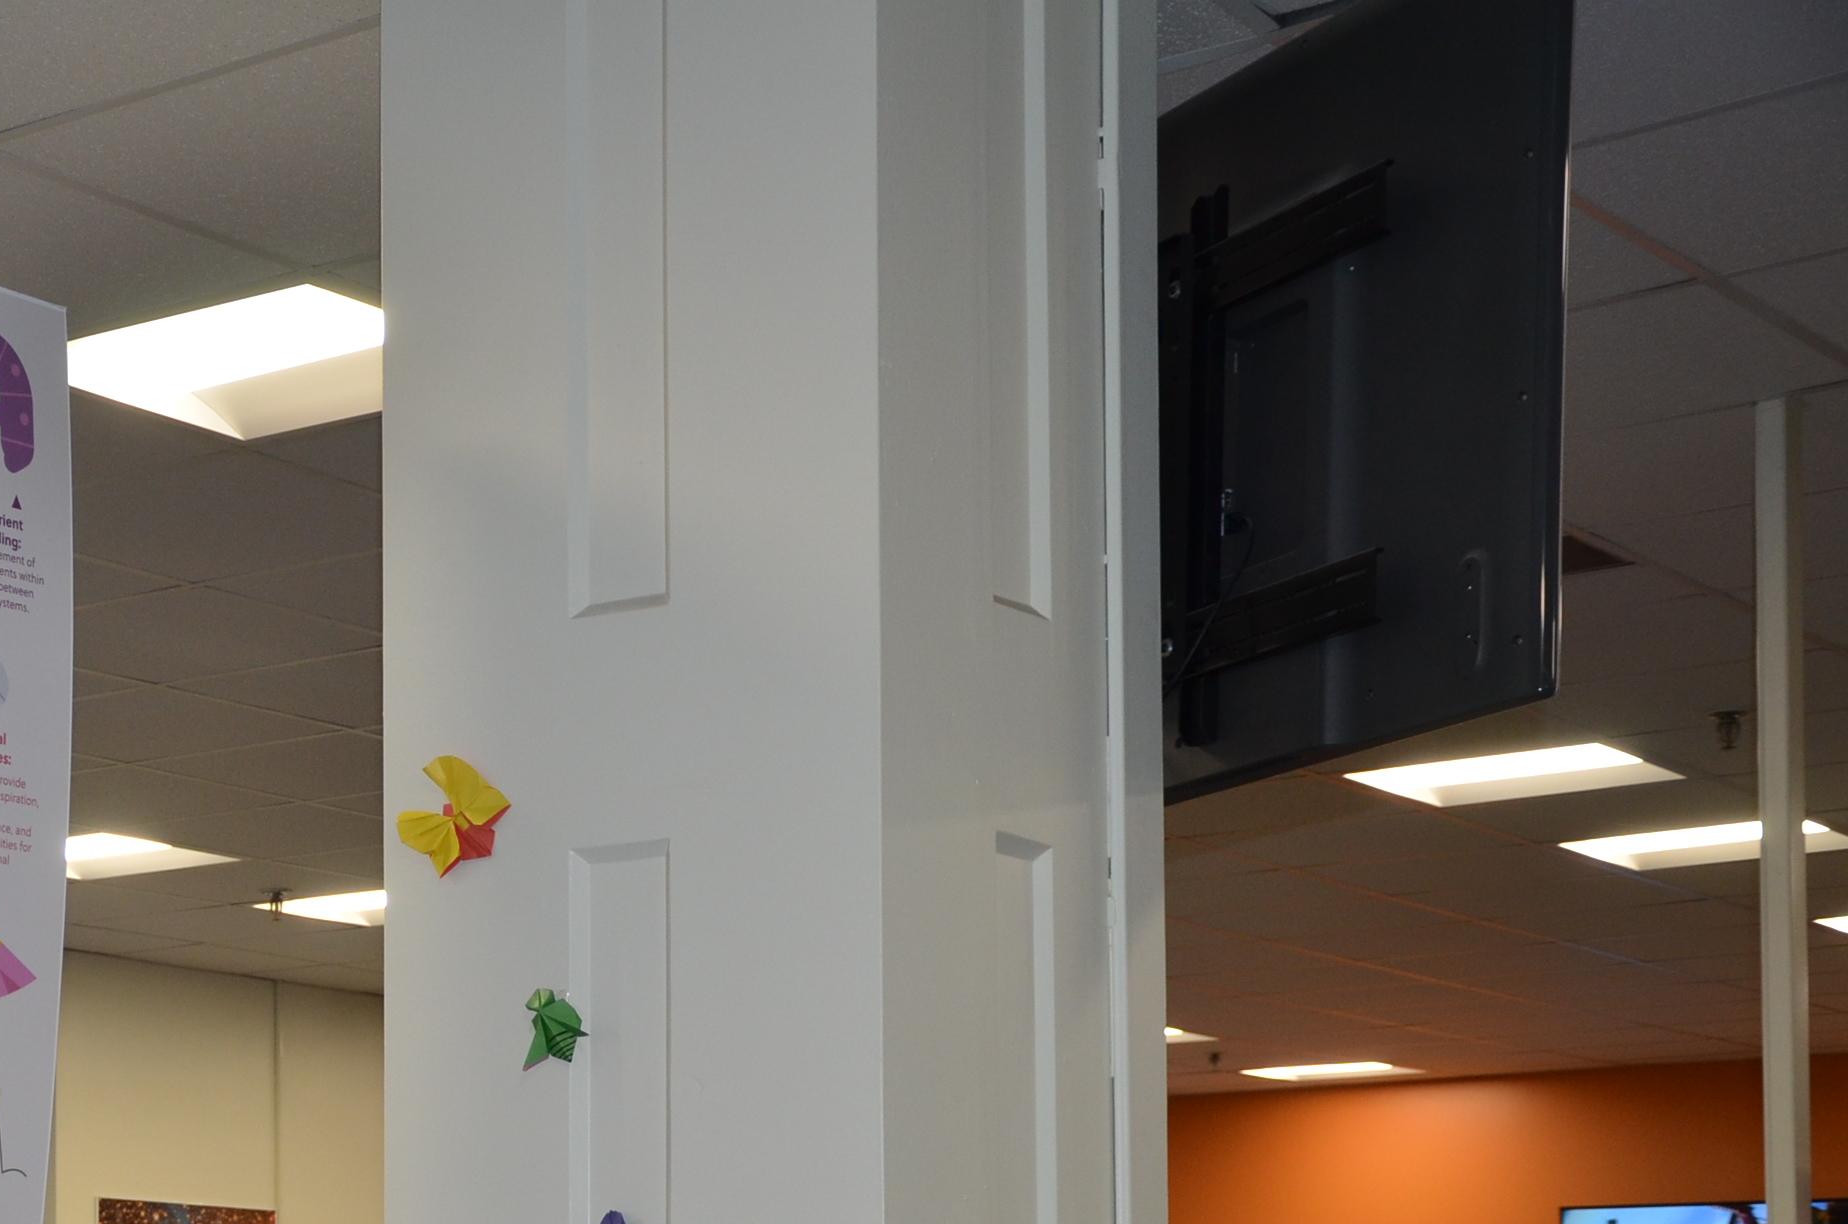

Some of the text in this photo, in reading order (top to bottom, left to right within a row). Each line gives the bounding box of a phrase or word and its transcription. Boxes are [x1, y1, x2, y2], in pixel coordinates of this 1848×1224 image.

[26, 557, 35, 568] of
[18, 572, 44, 585] within
[15, 826, 32, 837] and
[19, 840, 32, 852] for
